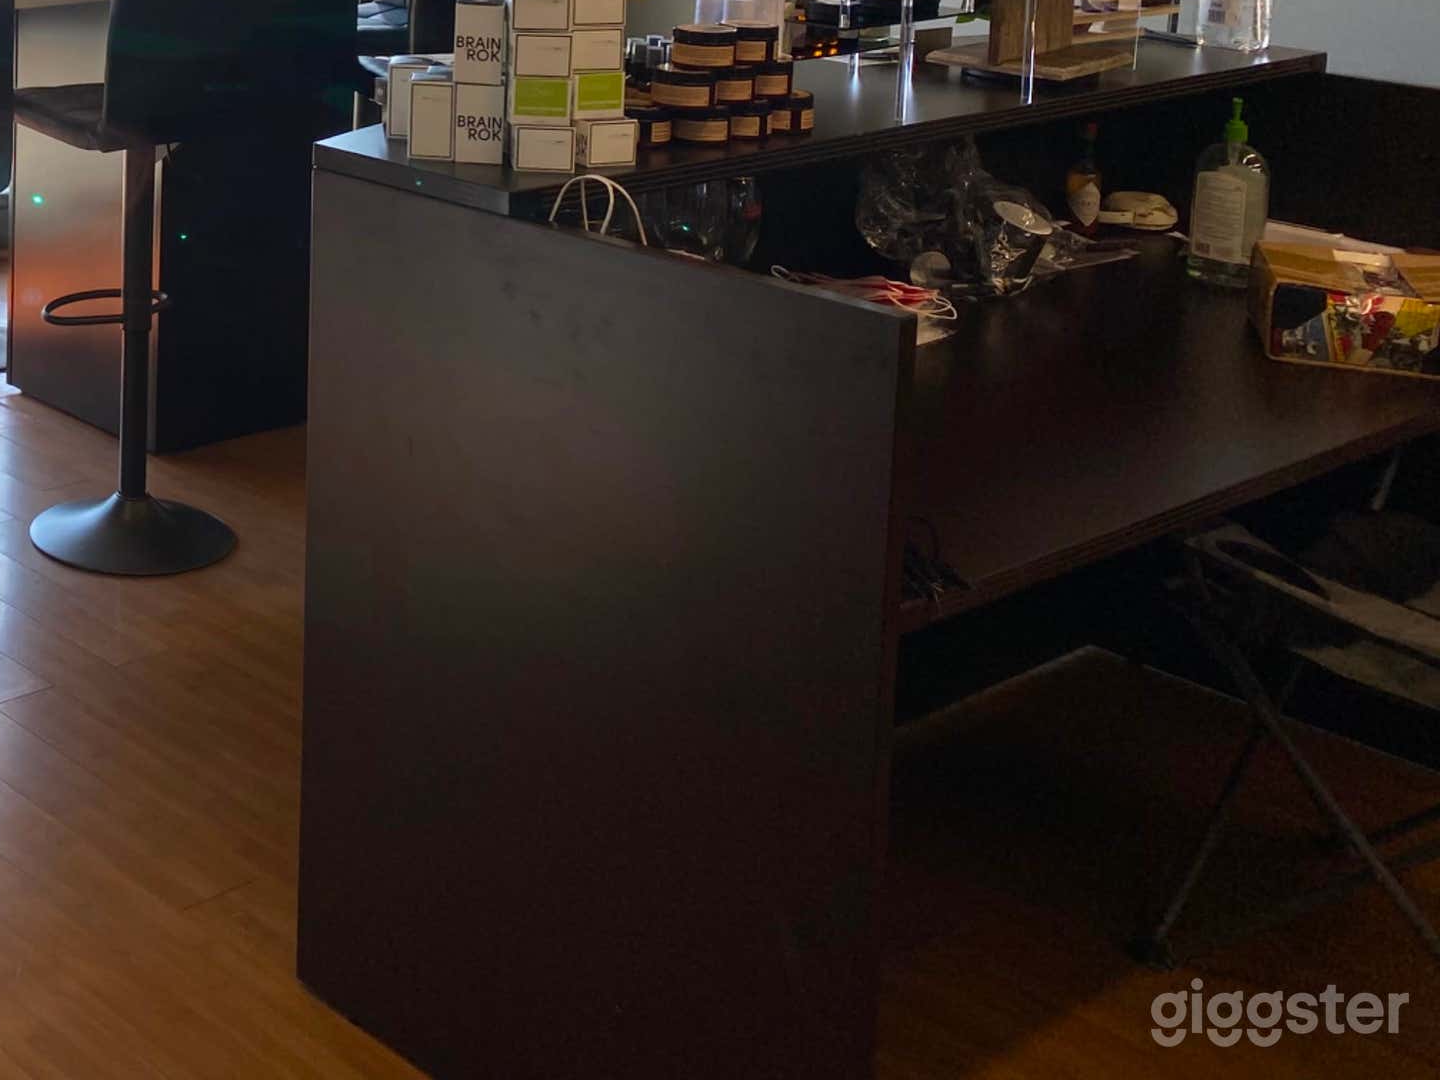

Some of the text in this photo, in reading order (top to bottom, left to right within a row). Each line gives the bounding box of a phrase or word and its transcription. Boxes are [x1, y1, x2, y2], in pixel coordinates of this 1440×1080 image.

[456, 36, 501, 50] BRAIN
[467, 49, 500, 63] ROK
[457, 115, 502, 129] BRAIN
[468, 128, 501, 142] ROK
